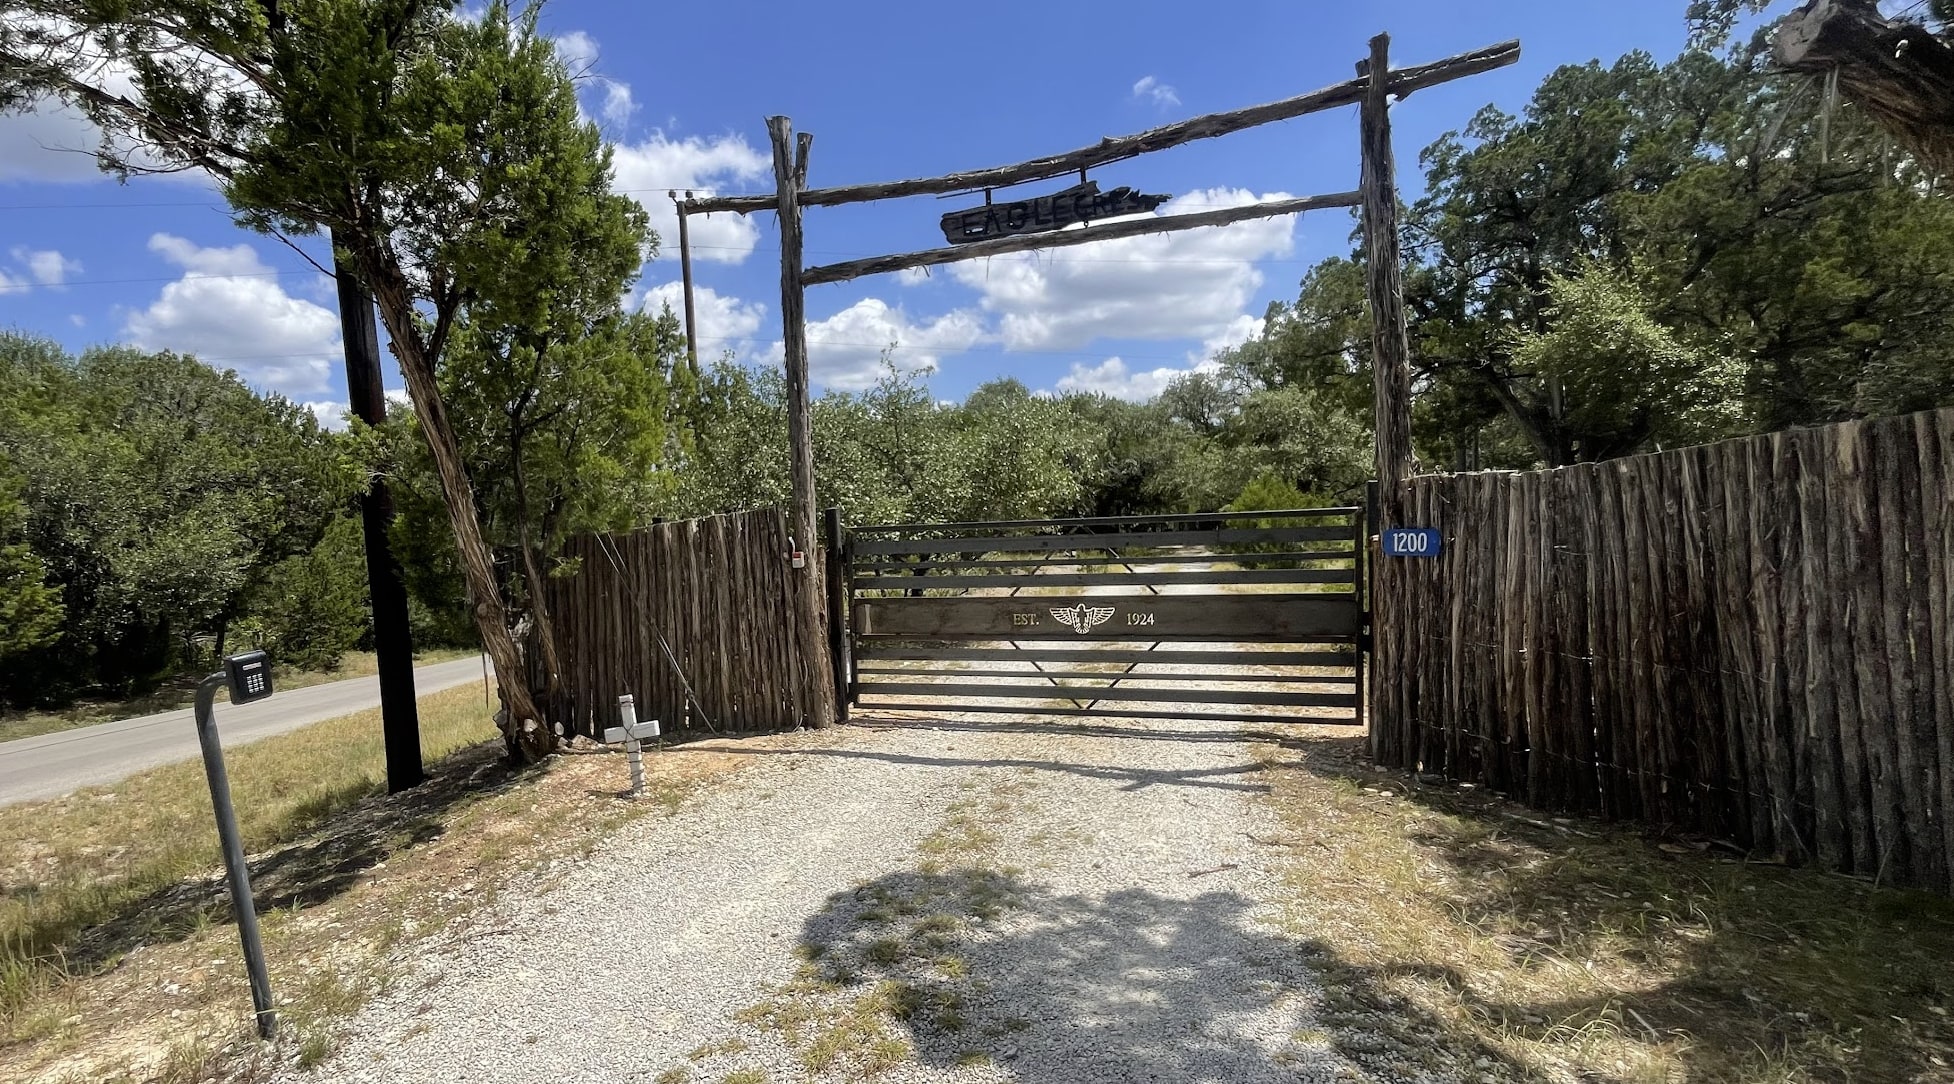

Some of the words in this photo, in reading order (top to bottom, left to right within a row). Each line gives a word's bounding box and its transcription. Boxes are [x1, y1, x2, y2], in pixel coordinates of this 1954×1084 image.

[1393, 532, 1427, 552] 1200
[1013, 613, 1040, 626] EST.
[1126, 613, 1155, 626] 1924
